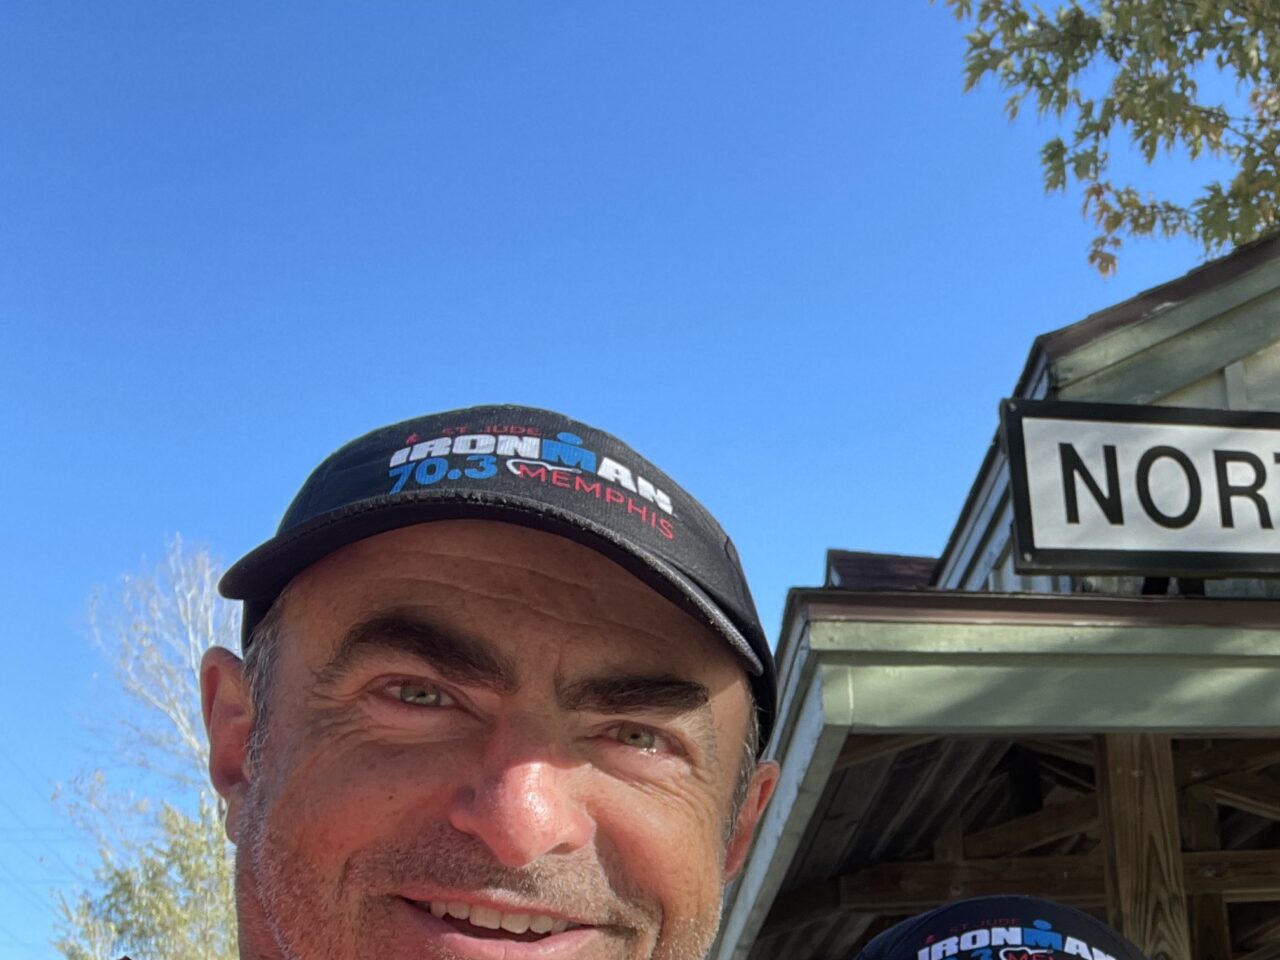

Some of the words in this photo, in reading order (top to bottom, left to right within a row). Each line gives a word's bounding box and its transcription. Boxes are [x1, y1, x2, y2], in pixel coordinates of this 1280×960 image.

[485, 424, 541, 436] JUDE
[388, 455, 498, 495] 70.3
[389, 432, 674, 516] IRONMAN
[518, 463, 675, 540] MEMPHIS
